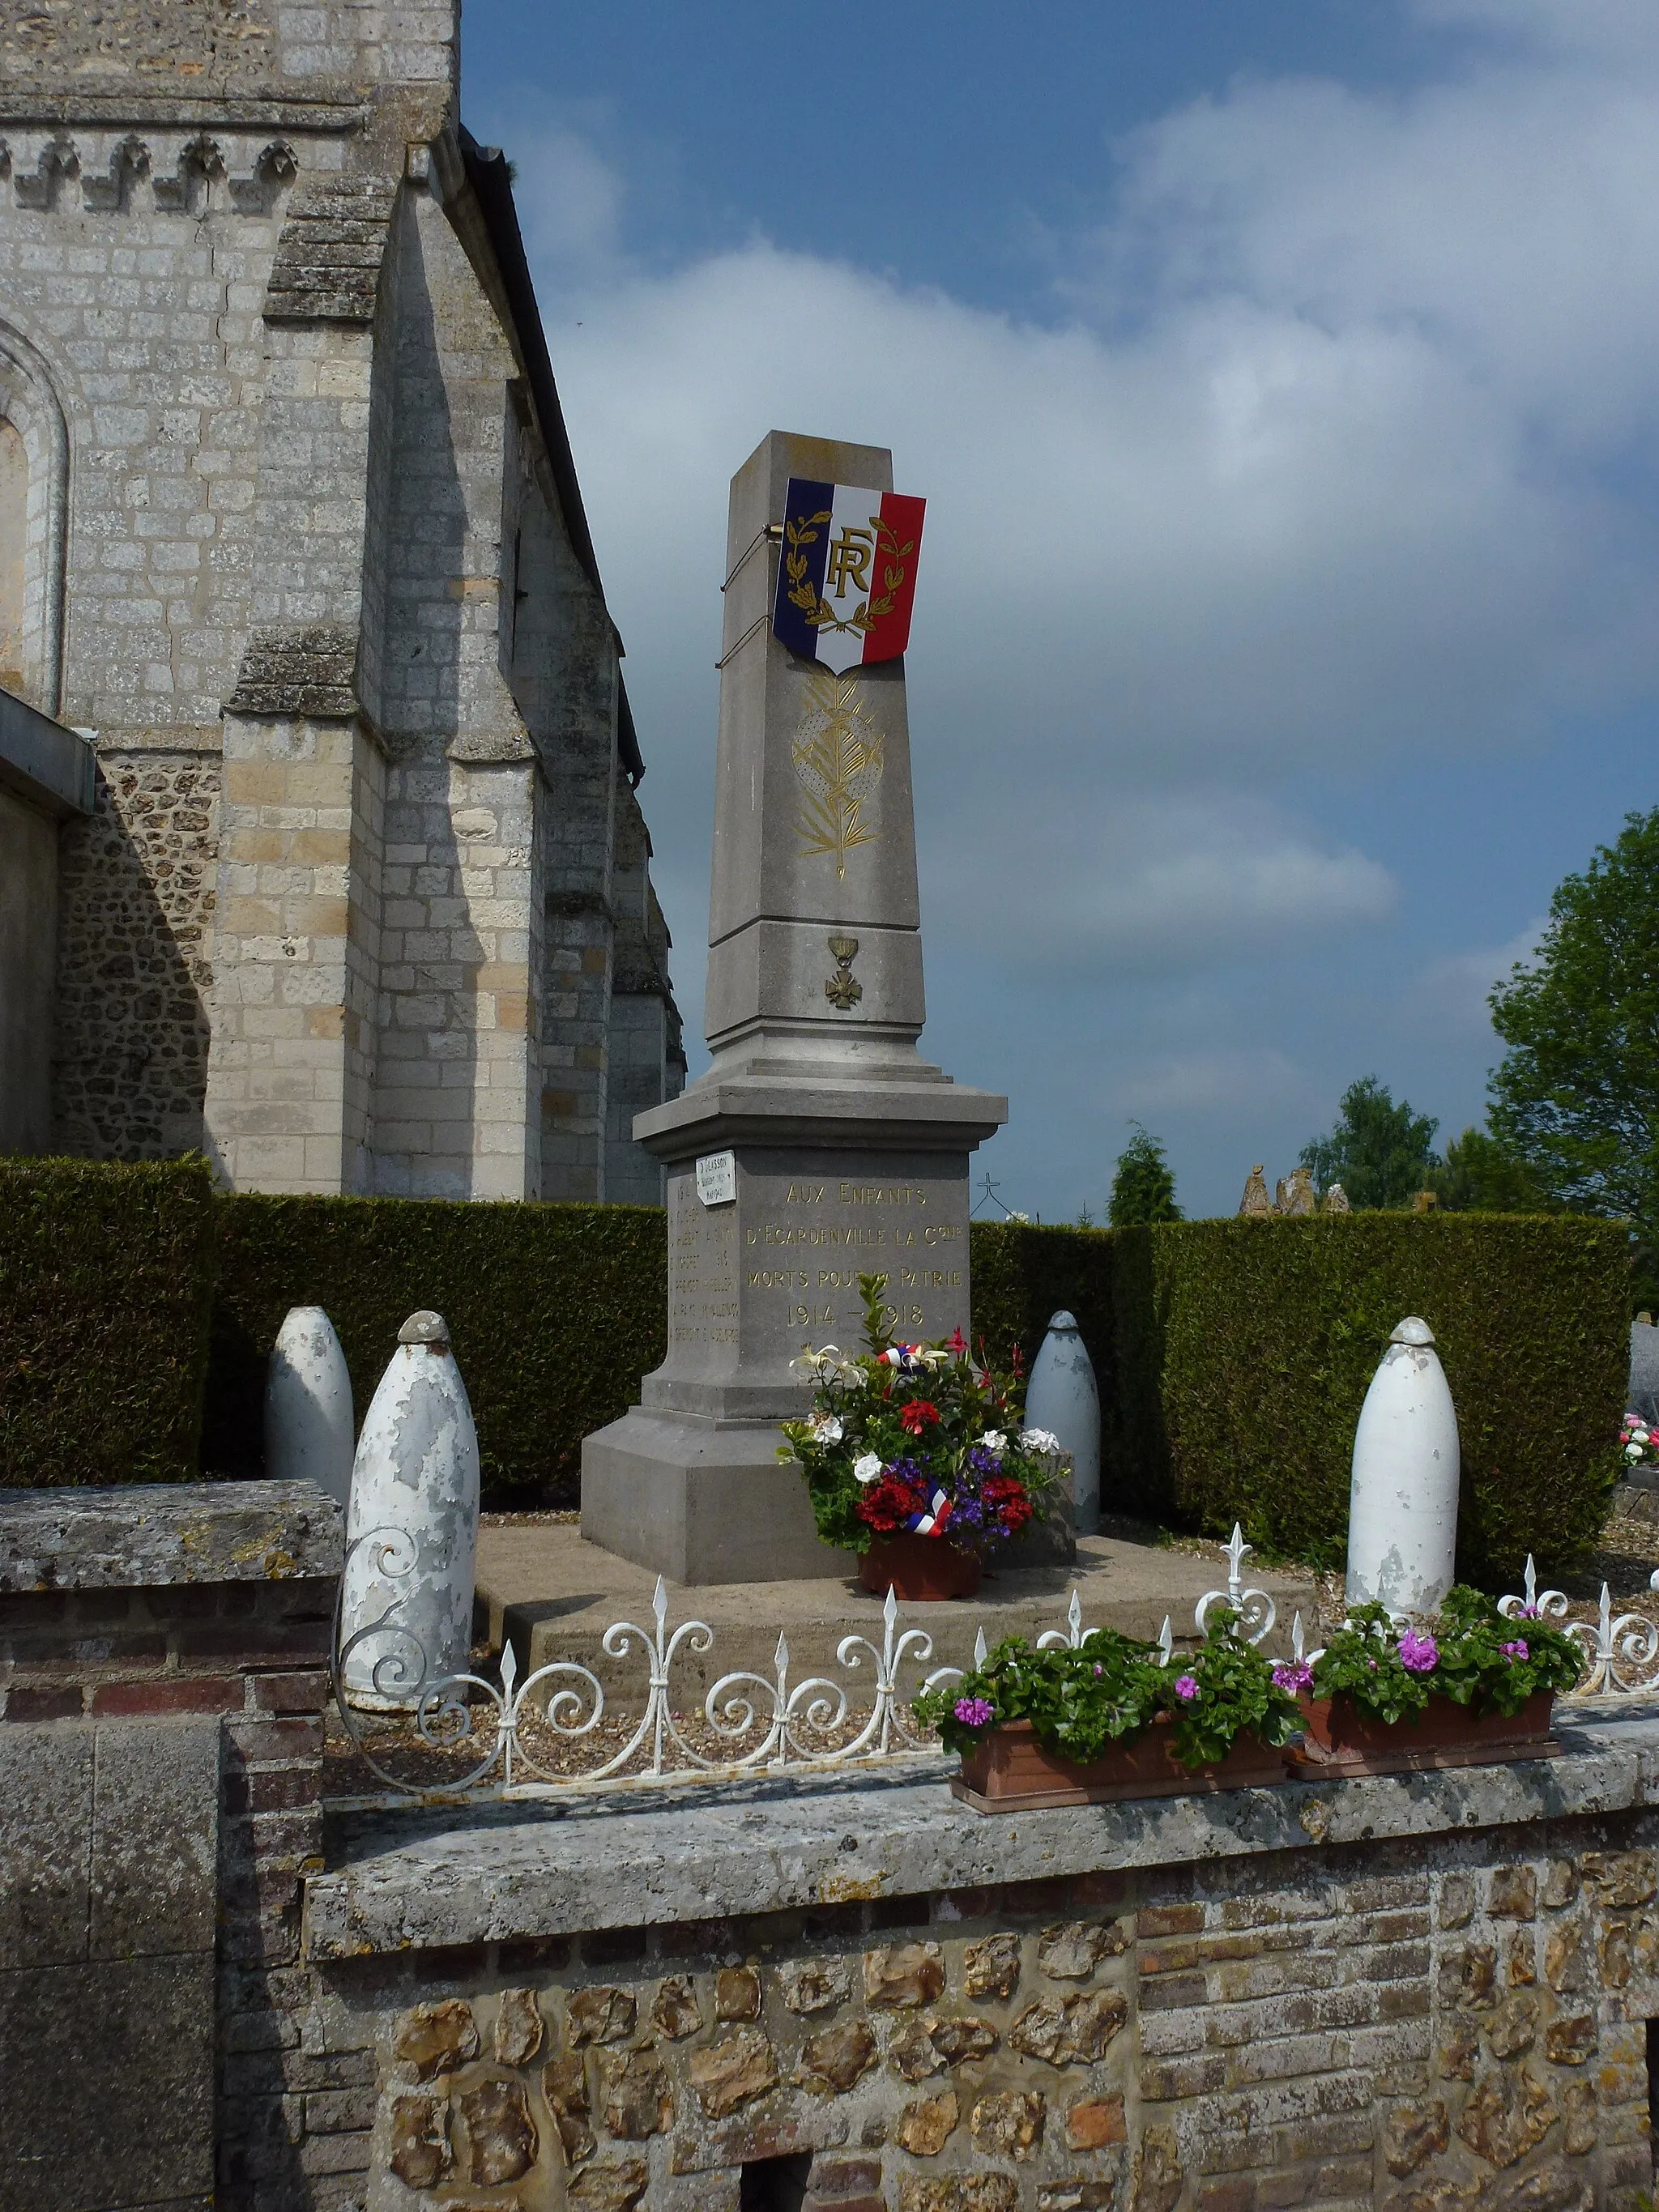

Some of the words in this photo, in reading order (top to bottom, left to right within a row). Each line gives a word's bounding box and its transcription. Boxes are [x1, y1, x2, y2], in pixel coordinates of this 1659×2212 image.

[786, 1183, 825, 1204] AUX
[839, 1183, 927, 1205] ENFANTS
[894, 1228, 917, 1246] LA
[748, 1270, 808, 1288] MORTS
[872, 1271, 890, 1287] A
[900, 1267, 962, 1287] PATRIE
[787, 1304, 836, 1327] 1914
[880, 1304, 923, 1325] 918
